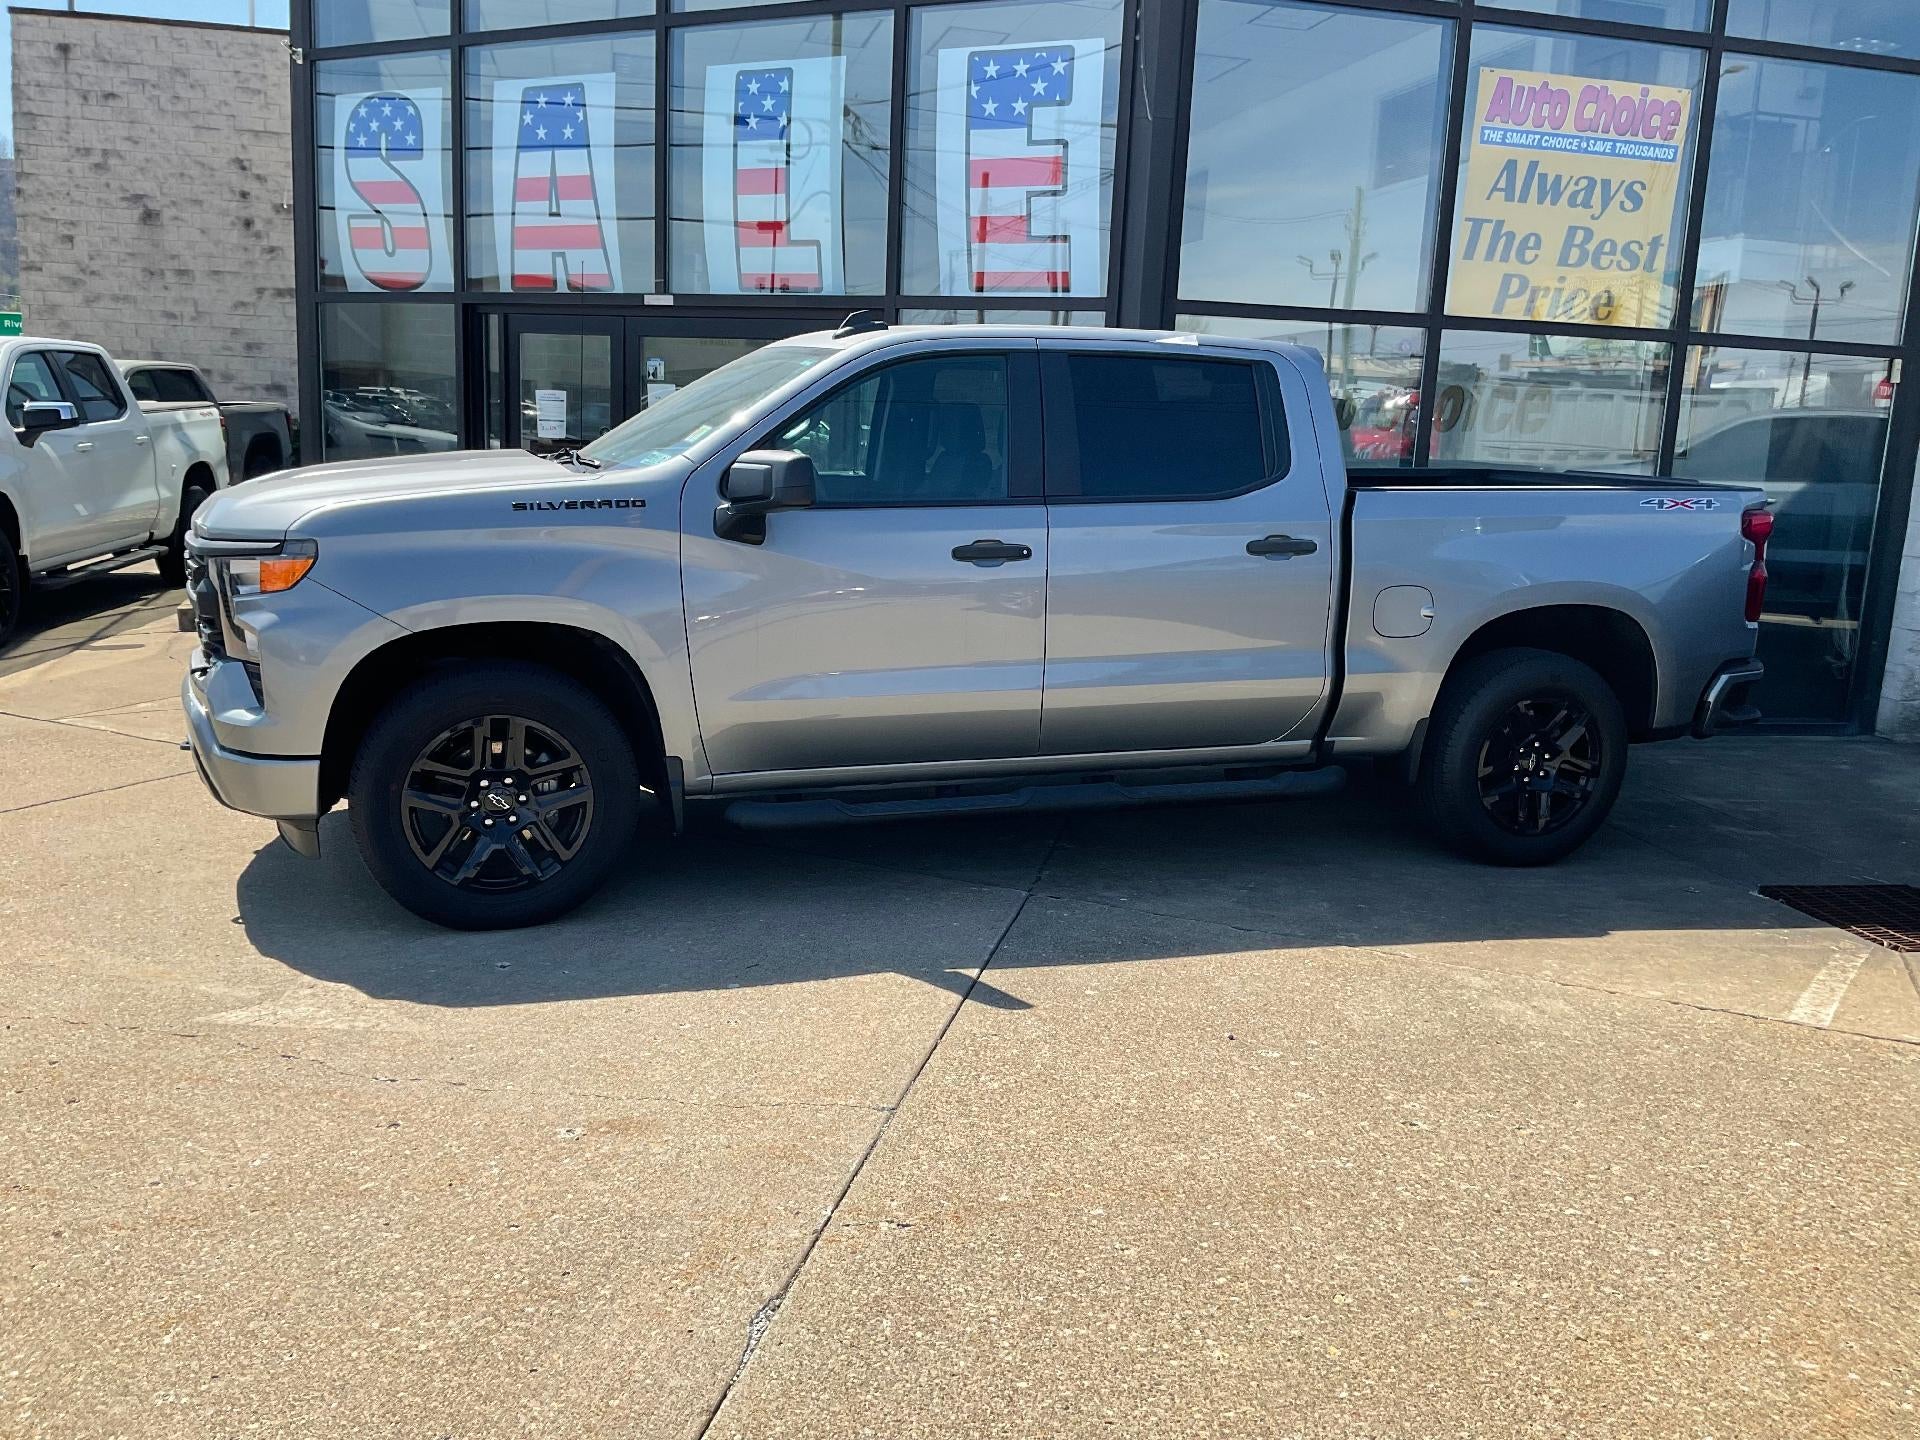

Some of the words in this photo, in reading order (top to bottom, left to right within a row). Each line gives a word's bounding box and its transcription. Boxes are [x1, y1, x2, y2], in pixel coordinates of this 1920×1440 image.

[1484, 76, 1570, 130] Auto
[1574, 84, 1681, 141] Choice
[345, 45, 1075, 293] SALE
[1483, 129, 1504, 142] THE
[1505, 131, 1541, 146] SMART
[1541, 135, 1581, 150] CHOICE
[1587, 139, 1613, 153] SAVE
[1615, 142, 1675, 160] THOUSANDS
[1486, 158, 1647, 220] Always
[1461, 217, 1542, 265] The
[1556, 225, 1665, 273] Best
[1491, 273, 1616, 321] Price
[511, 499, 647, 511] SILVERADO
